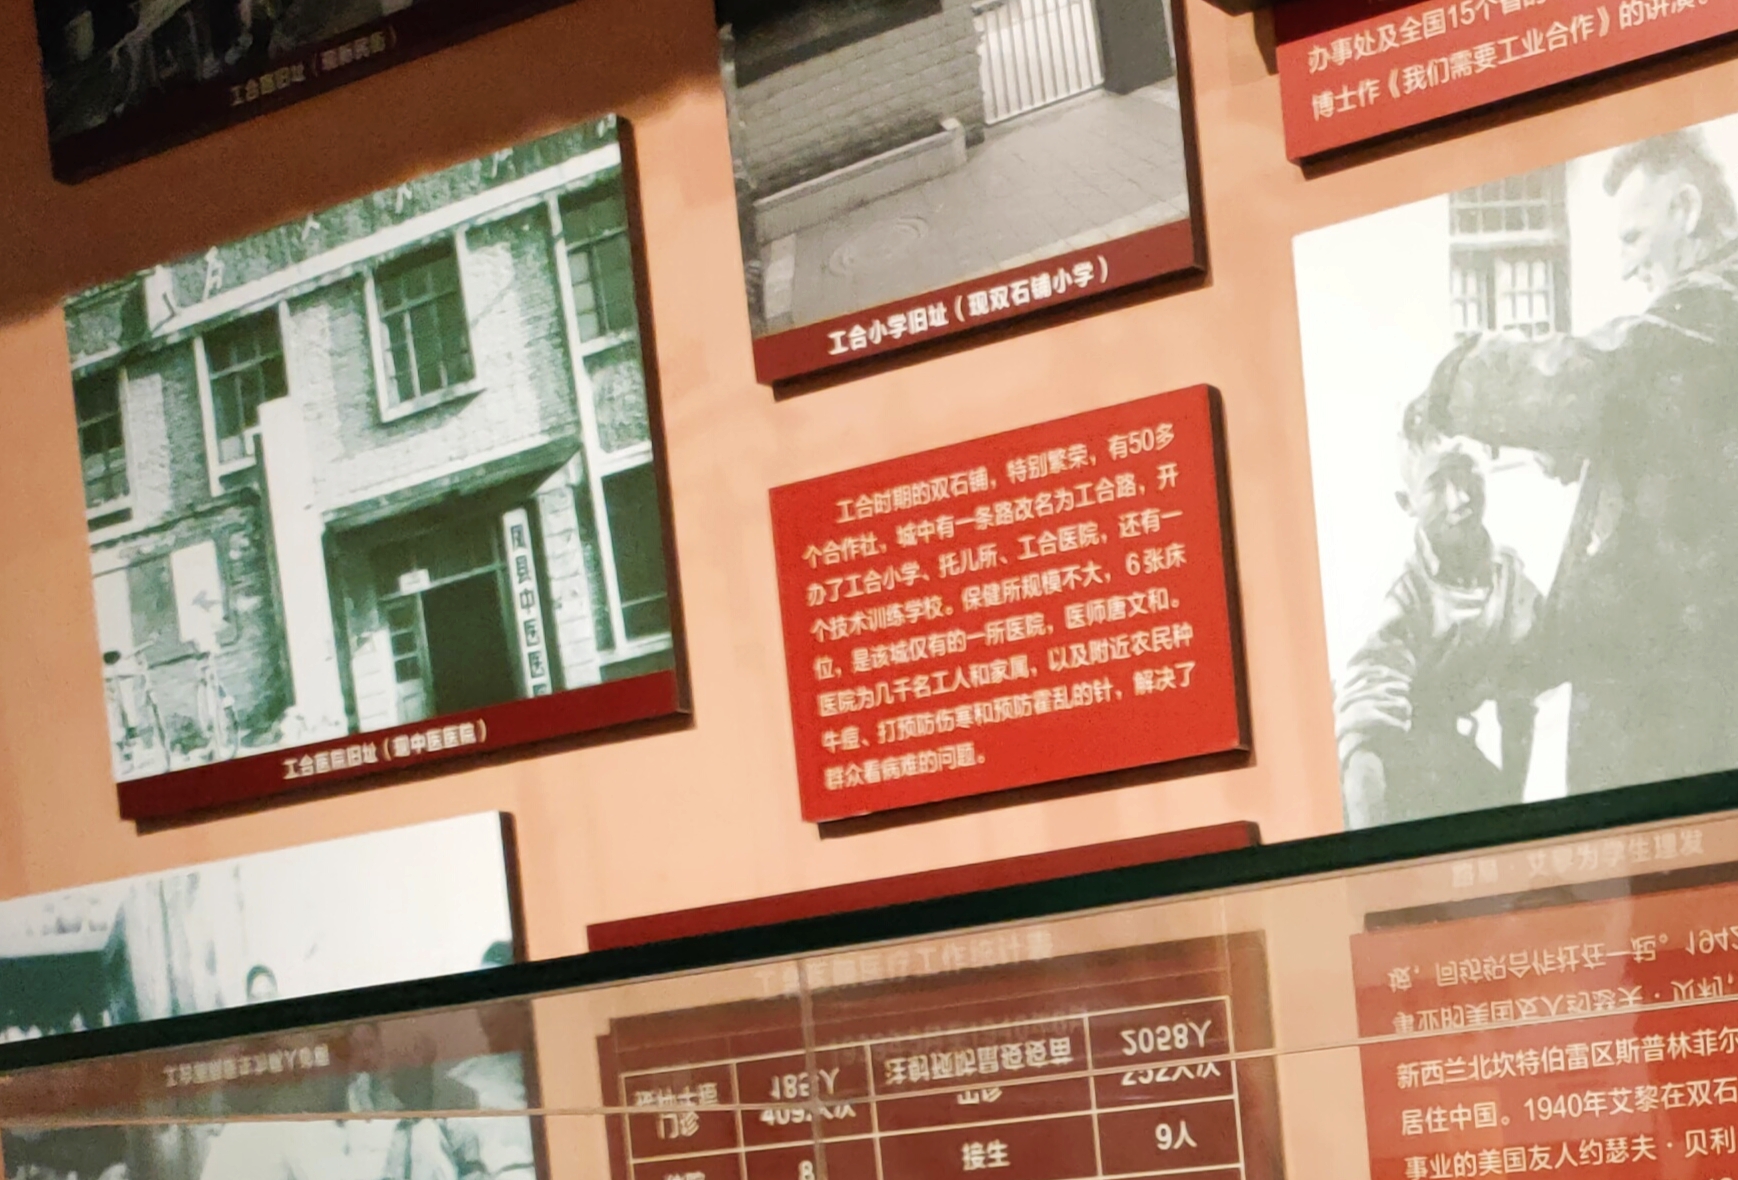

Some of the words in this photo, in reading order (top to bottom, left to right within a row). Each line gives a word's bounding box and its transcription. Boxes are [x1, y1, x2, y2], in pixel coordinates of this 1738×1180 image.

[828, 255, 1109, 355] 工合小学旧址（现双石铺小学）
[802, 462, 1180, 567] 个合作社，城中有一条路改名为工合路，开
[836, 422, 1175, 525] 工合时期的双石铺，特别繁荣，有50多
[806, 510, 1183, 606] 办了工合小学、托儿所、工合医院，还有一
[824, 741, 986, 791] 群众看病难的问题。
[961, 1138, 1011, 1171] 接生
[1154, 1119, 1199, 1151] 9人
